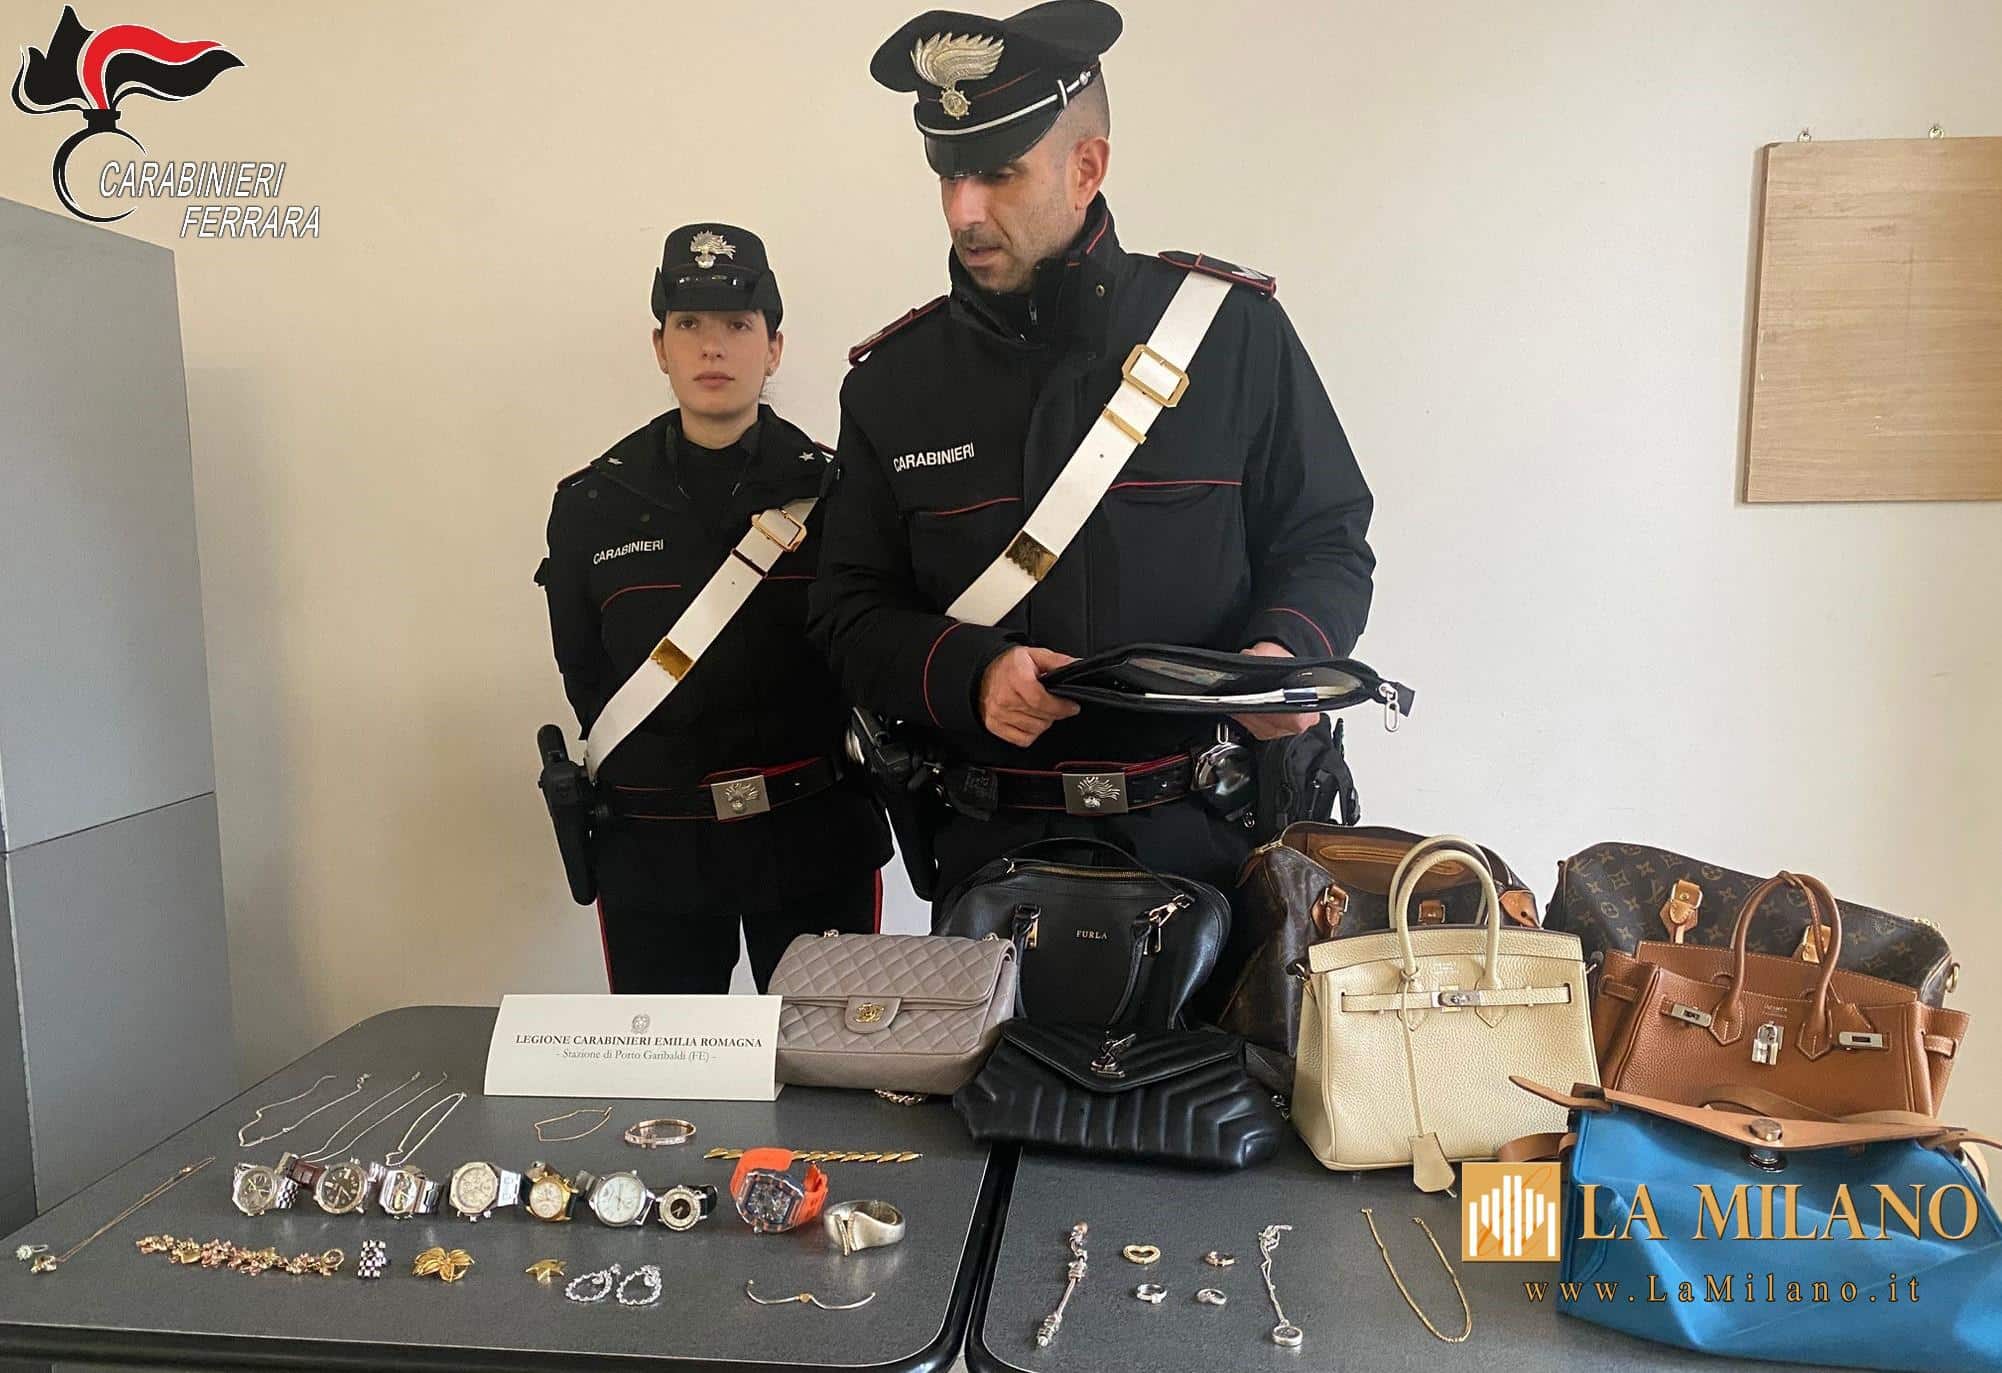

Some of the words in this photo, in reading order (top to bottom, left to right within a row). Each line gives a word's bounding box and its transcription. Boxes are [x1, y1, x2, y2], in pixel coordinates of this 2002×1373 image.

[893, 441, 975, 473] CARABINIERI
[592, 538, 664, 565] CARABINIERI
[1076, 929, 1108, 940] FURLA
[515, 1034, 571, 1045] LEGIONE
[573, 1035, 652, 1046] CARABINIERI
[654, 1036, 697, 1047] EMILIA
[700, 1037, 763, 1048] ROMAGNA
[562, 1048, 601, 1059] Stazione
[603, 1049, 613, 1060] di
[615, 1049, 641, 1060] Porto
[643, 1049, 686, 1061] Garibaldi
[688, 1050, 710, 1063] (FE)
